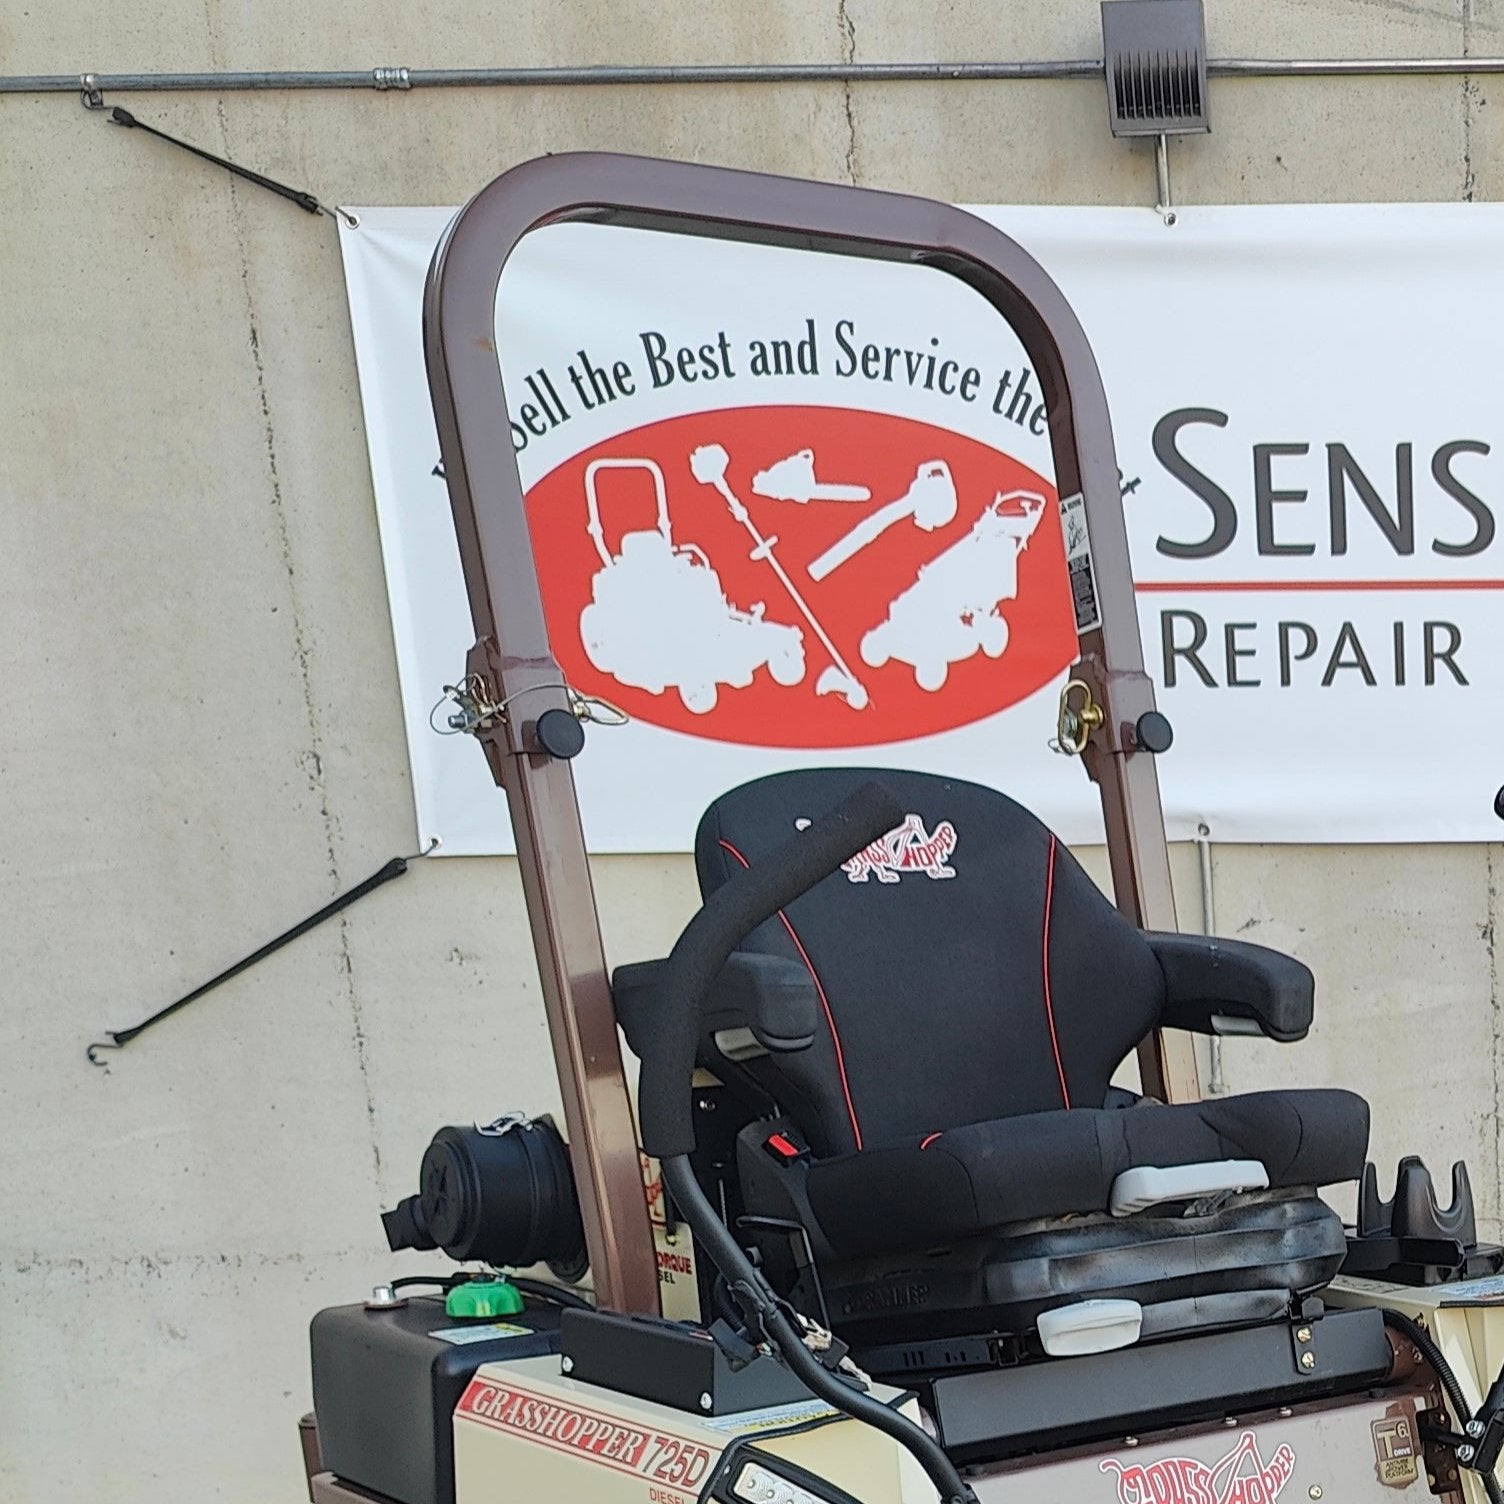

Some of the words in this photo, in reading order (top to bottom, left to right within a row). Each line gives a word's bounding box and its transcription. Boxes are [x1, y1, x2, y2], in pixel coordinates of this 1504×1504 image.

[567, 350, 636, 410] the
[639, 331, 736, 389] Best
[749, 319, 819, 376] and
[835, 320, 981, 402] Service
[992, 367, 1047, 436] the
[1160, 609, 1470, 689] REPAIR
[656, 1251, 692, 1275] ORQUE
[658, 1271, 675, 1284] SEL
[471, 1386, 645, 1463] GRASSHOPPER
[645, 1435, 710, 1488] 725D
[1393, 1446, 1411, 1457] DRIVE
